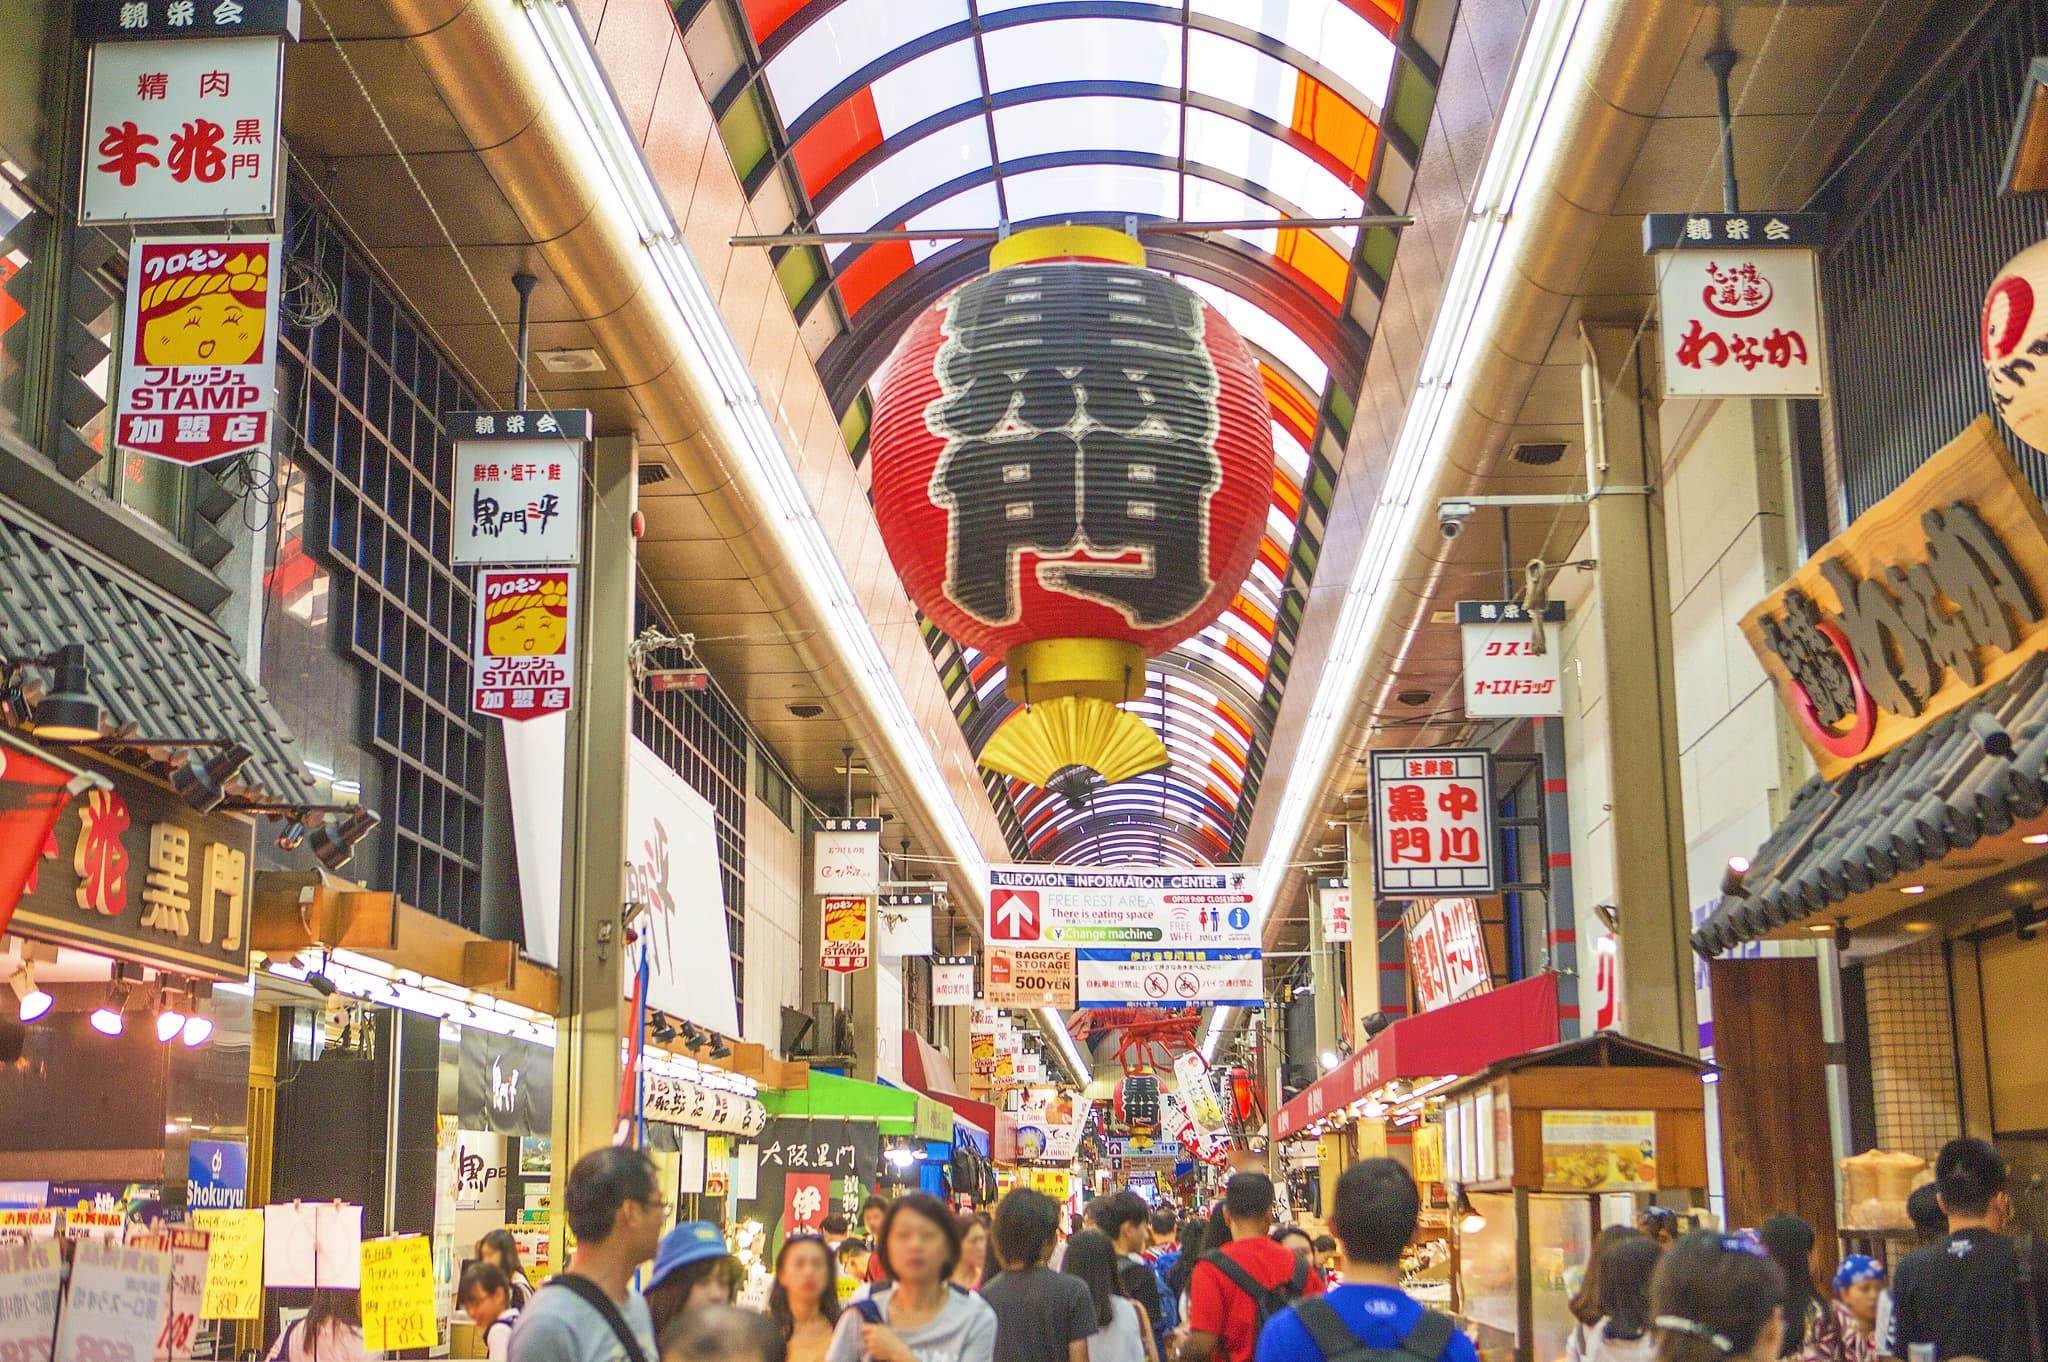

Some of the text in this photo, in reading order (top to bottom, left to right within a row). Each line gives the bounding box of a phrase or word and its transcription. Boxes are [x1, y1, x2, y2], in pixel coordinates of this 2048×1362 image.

[120, 0, 244, 28] 親栄会
[137, 70, 230, 101] 精肉
[98, 119, 227, 187] 牛兆
[232, 119, 261, 180] 黒門
[1687, 218, 1790, 240] 親栄会
[145, 249, 227, 281] クロモン
[1676, 319, 1808, 372] わなか
[144, 367, 246, 387] フレッシュ
[131, 387, 260, 411] STAMP
[128, 415, 258, 444] 加盟店
[475, 414, 558, 434] 親栄会
[925, 262, 1222, 630] 黒門
[473, 464, 561, 482] 鮮魚・塩干・鮭
[472, 487, 559, 538] 黒門三平
[488, 578, 541, 600] クロモン
[1480, 604, 1535, 619] 親栄
[489, 657, 556, 670] フレッシュ
[482, 670, 565, 687] STAMP
[481, 690, 567, 709] 加盟店
[1388, 785, 1431, 864] 黒門
[1438, 784, 1480, 863] 中川
[141, 822, 246, 951] 黒門
[998, 872, 1218, 888] KUROMON INFORMATION CENTER
[1048, 894, 1156, 908] FREE REST AREA
[1051, 908, 1154, 922] There is eating space
[1169, 921, 1192, 930] FREE
[1066, 928, 1105, 941] Change
[1108, 928, 1153, 940] machine
[1169, 932, 1193, 941] Wi-Fi
[824, 948, 865, 956] STAMP
[1015, 951, 1071, 960] BAGGAGE
[1015, 961, 1071, 970] STORAGE
[760, 1141, 857, 1169] 大阪黒門
[187, 1179, 243, 1210] Shokuryu
[792, 1185, 822, 1235] 伊
